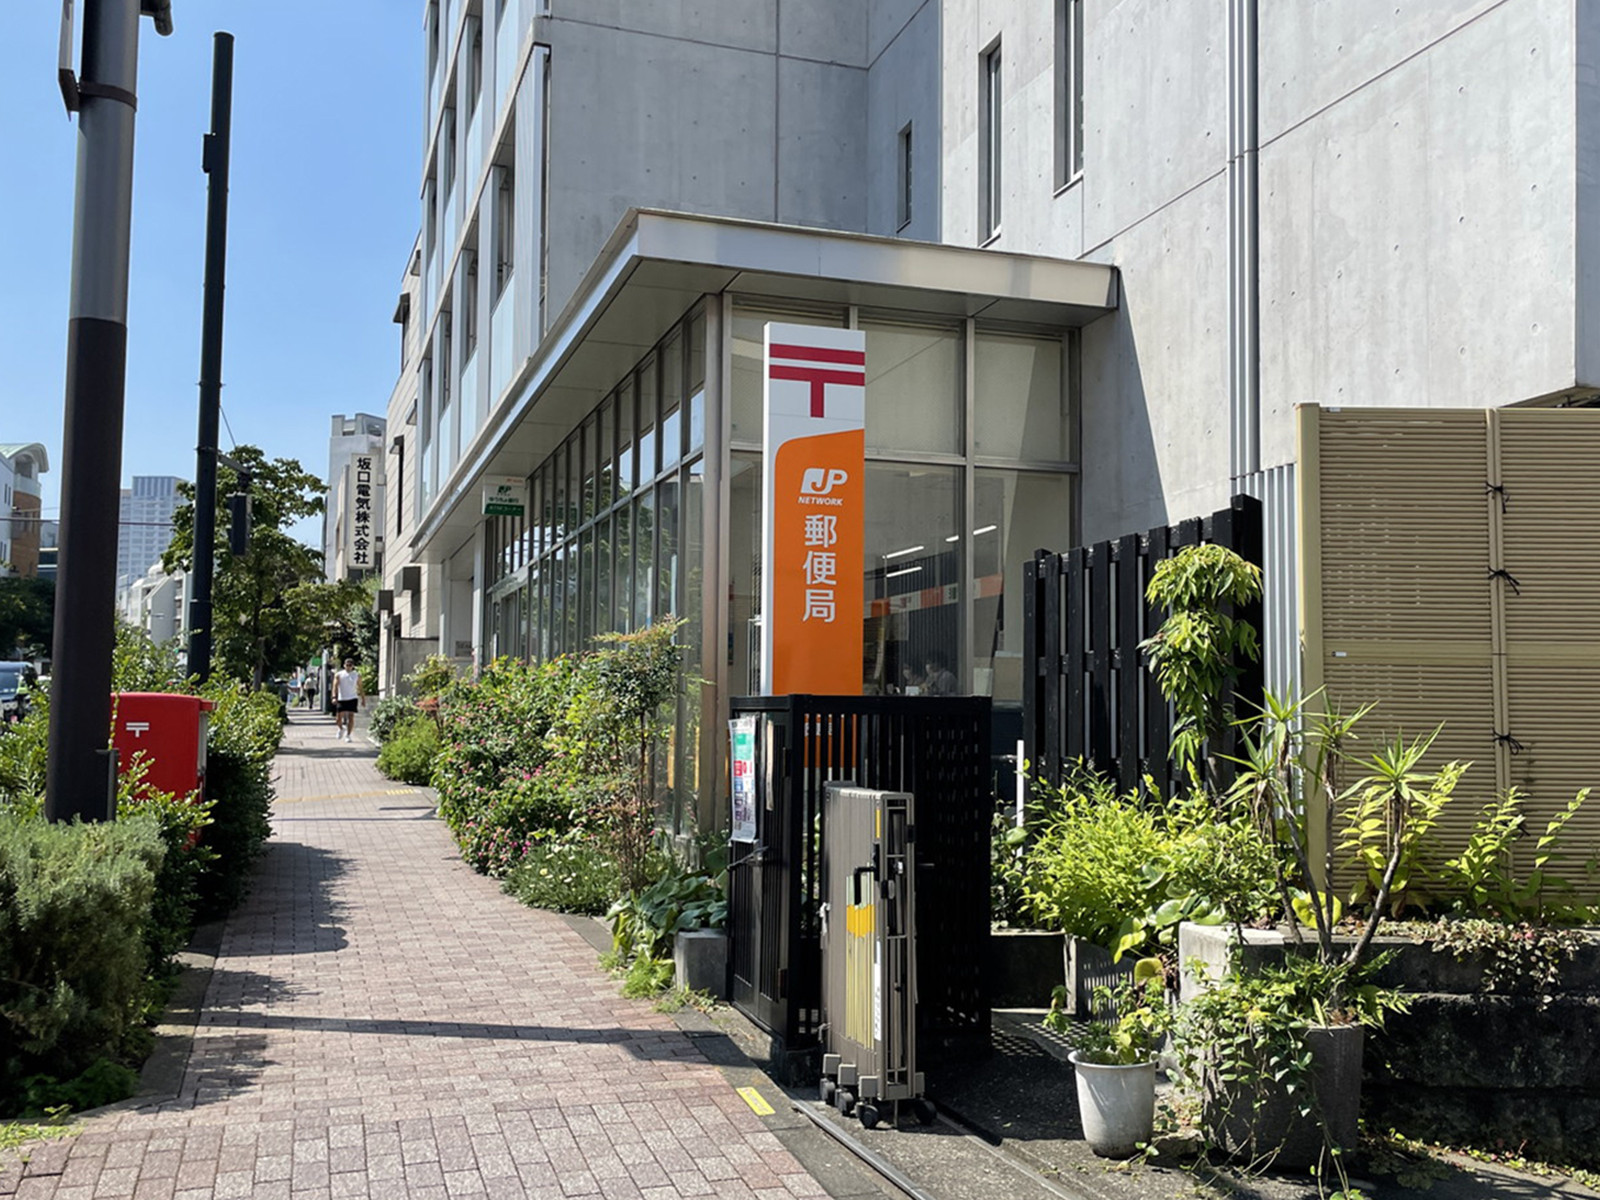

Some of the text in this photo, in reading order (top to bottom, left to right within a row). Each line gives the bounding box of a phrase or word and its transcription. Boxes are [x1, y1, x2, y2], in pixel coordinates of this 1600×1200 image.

[354, 457, 372, 565] 坂口電気株式会社
[798, 496, 844, 506] NETWORK
[800, 467, 848, 495] JP
[802, 514, 837, 624] 郵便局
